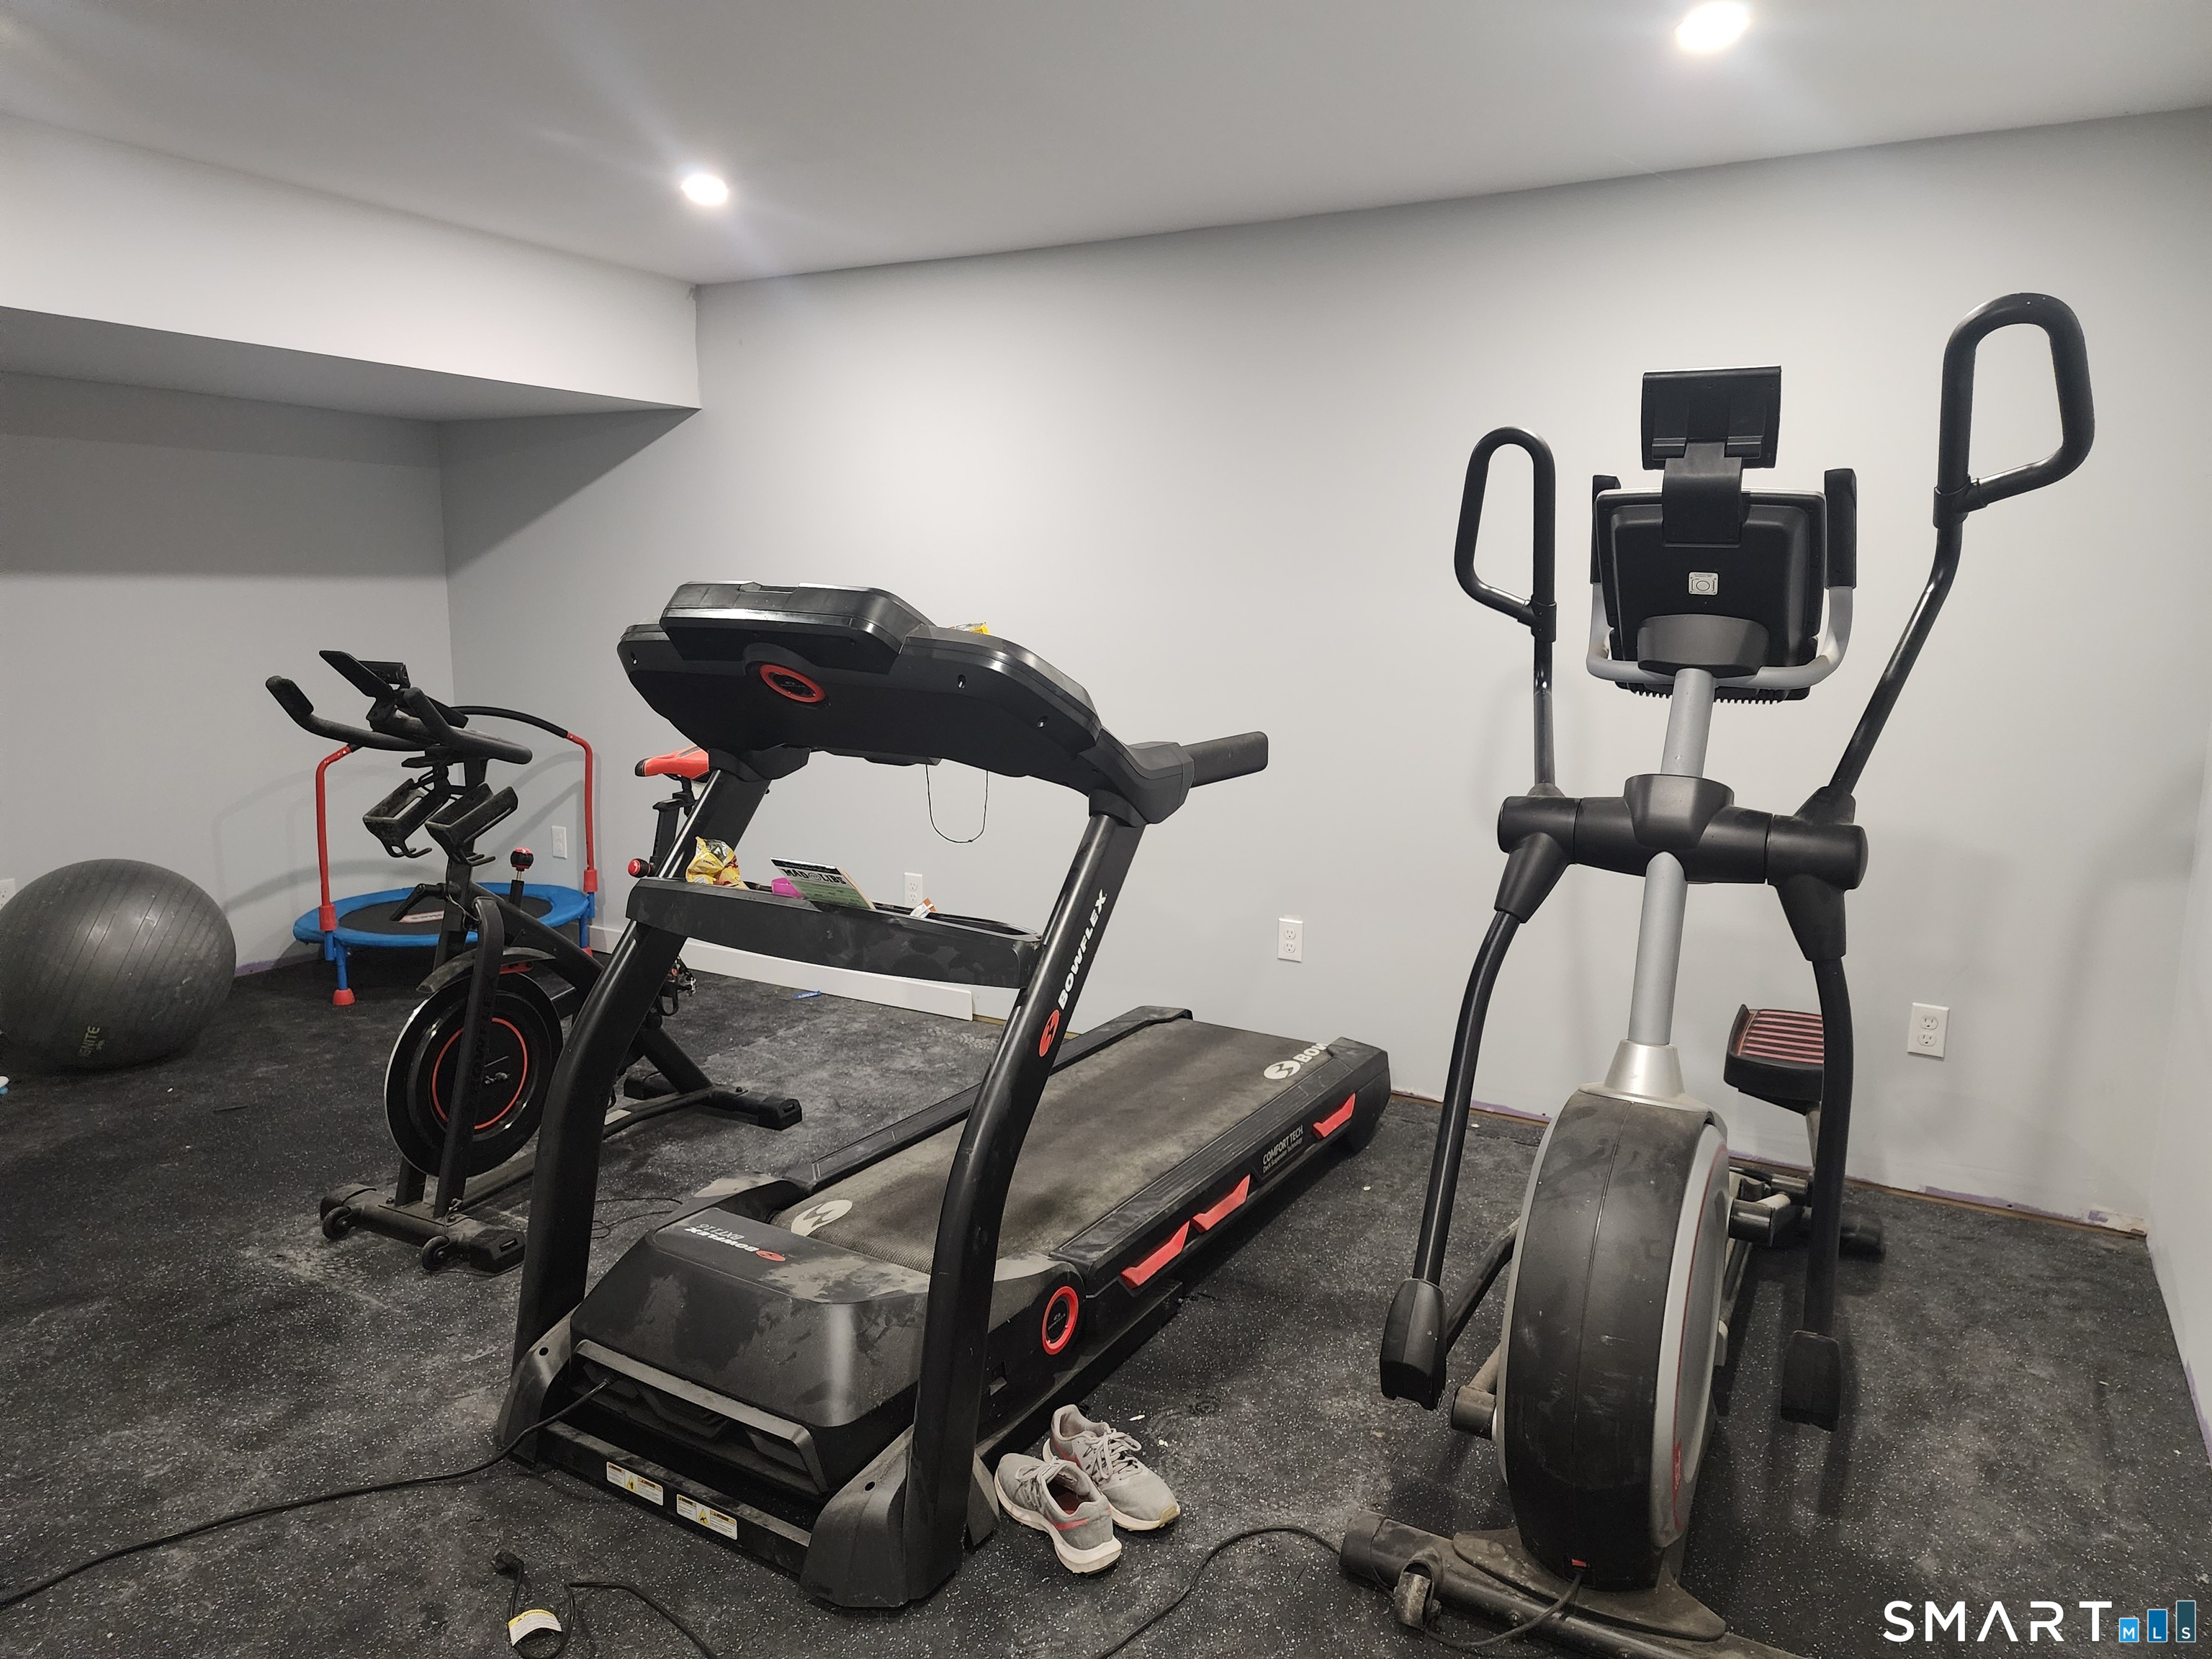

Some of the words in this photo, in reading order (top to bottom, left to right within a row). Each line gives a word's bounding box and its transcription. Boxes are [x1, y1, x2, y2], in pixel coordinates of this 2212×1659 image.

[781, 868, 809, 878] MAD
[820, 874, 846, 885] LIBS
[1058, 889, 1107, 1010] BOWFLEX
[1263, 1136, 1290, 1165] COMFORT
[1290, 1124, 1303, 1146] TECH
[684, 1226, 760, 1252] BOWFLEX
